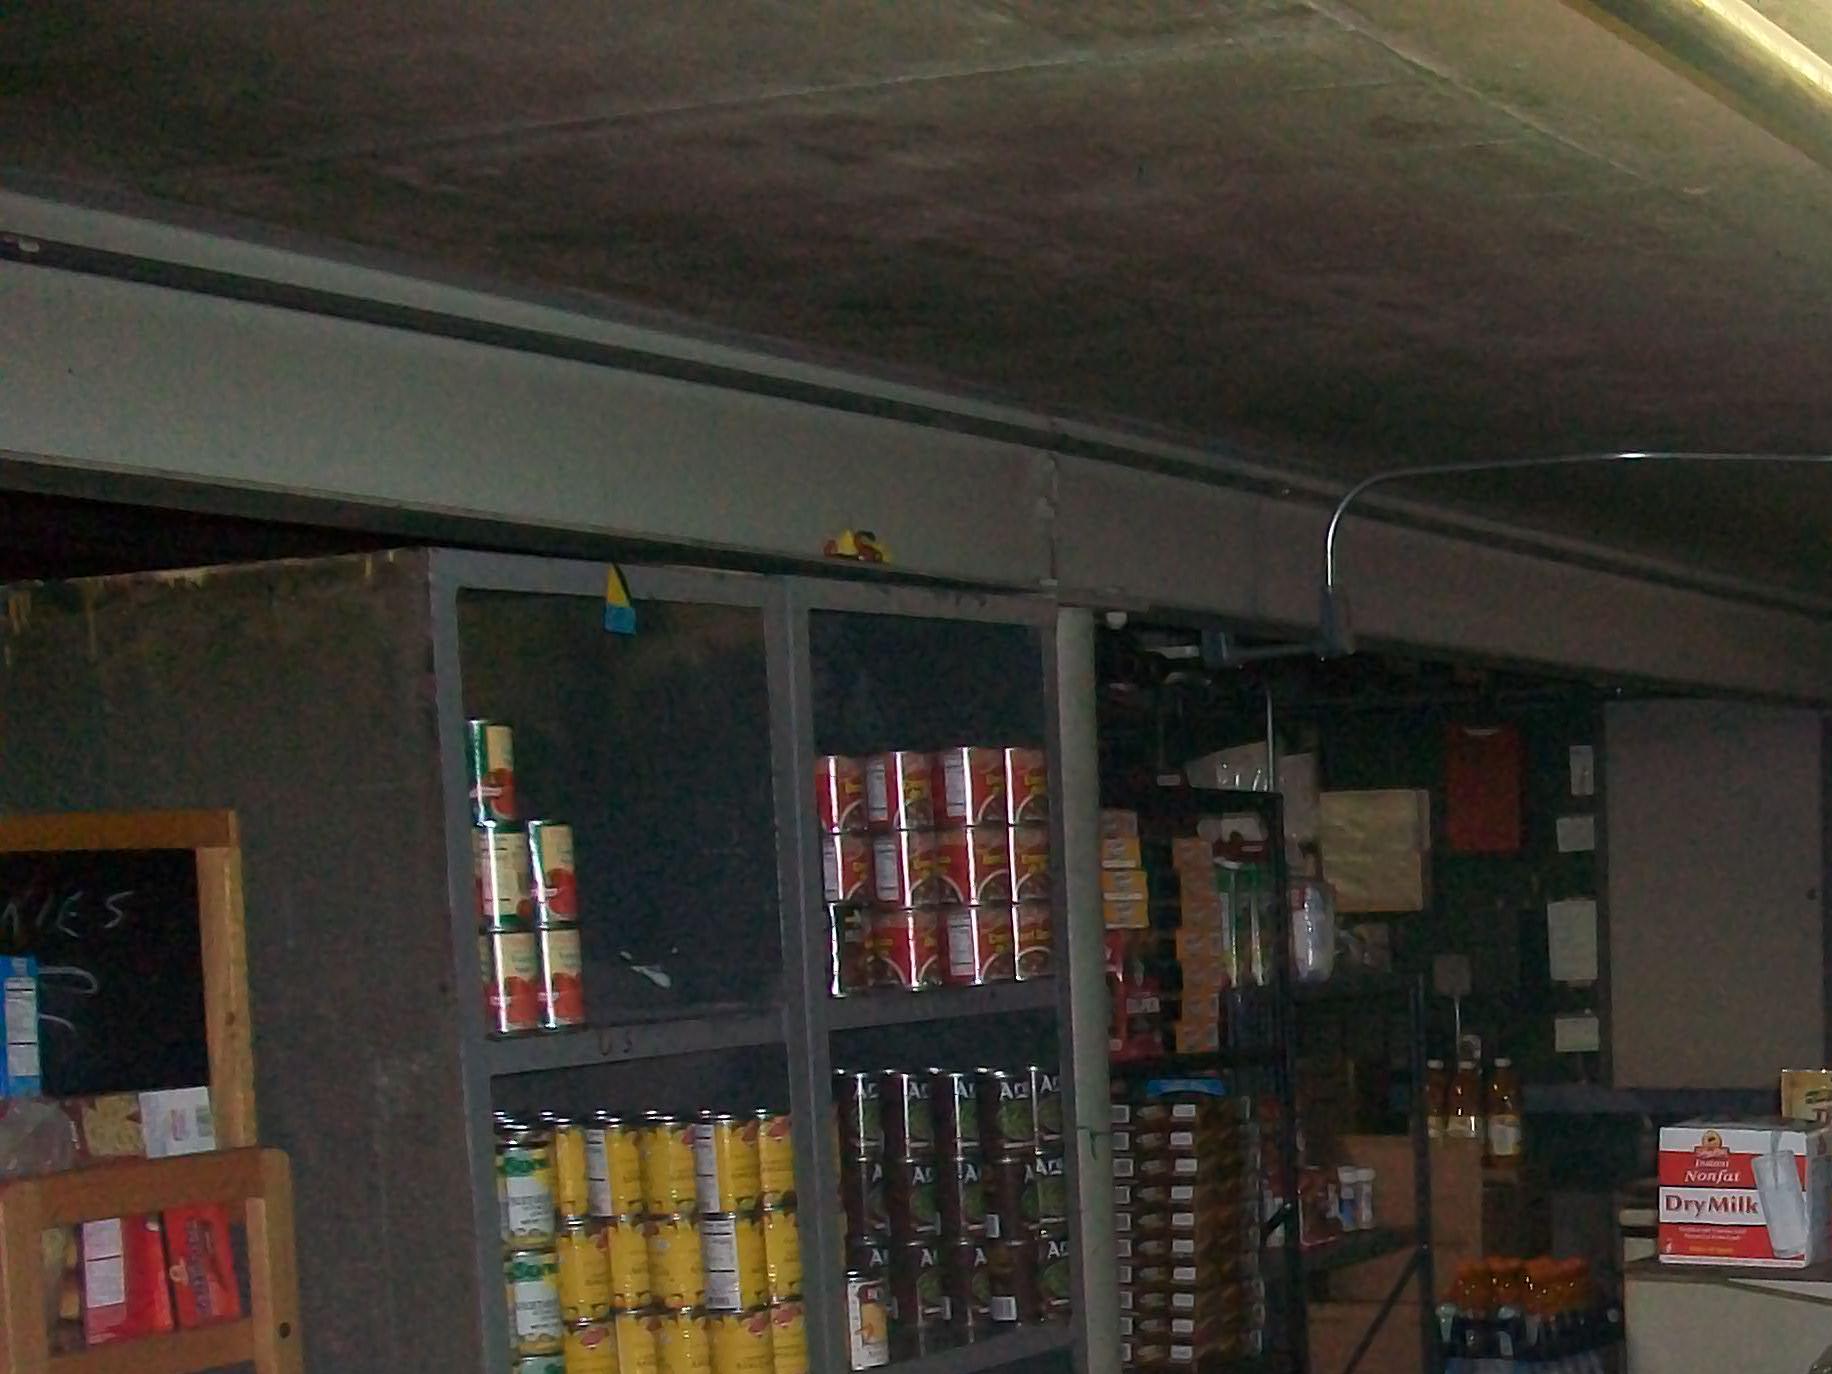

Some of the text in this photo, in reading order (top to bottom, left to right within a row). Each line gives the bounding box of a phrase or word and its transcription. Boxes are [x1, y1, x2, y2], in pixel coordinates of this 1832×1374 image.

[1684, 1168, 1741, 1184] Nonfat
[1665, 1194, 1760, 1219] Dry Milk
